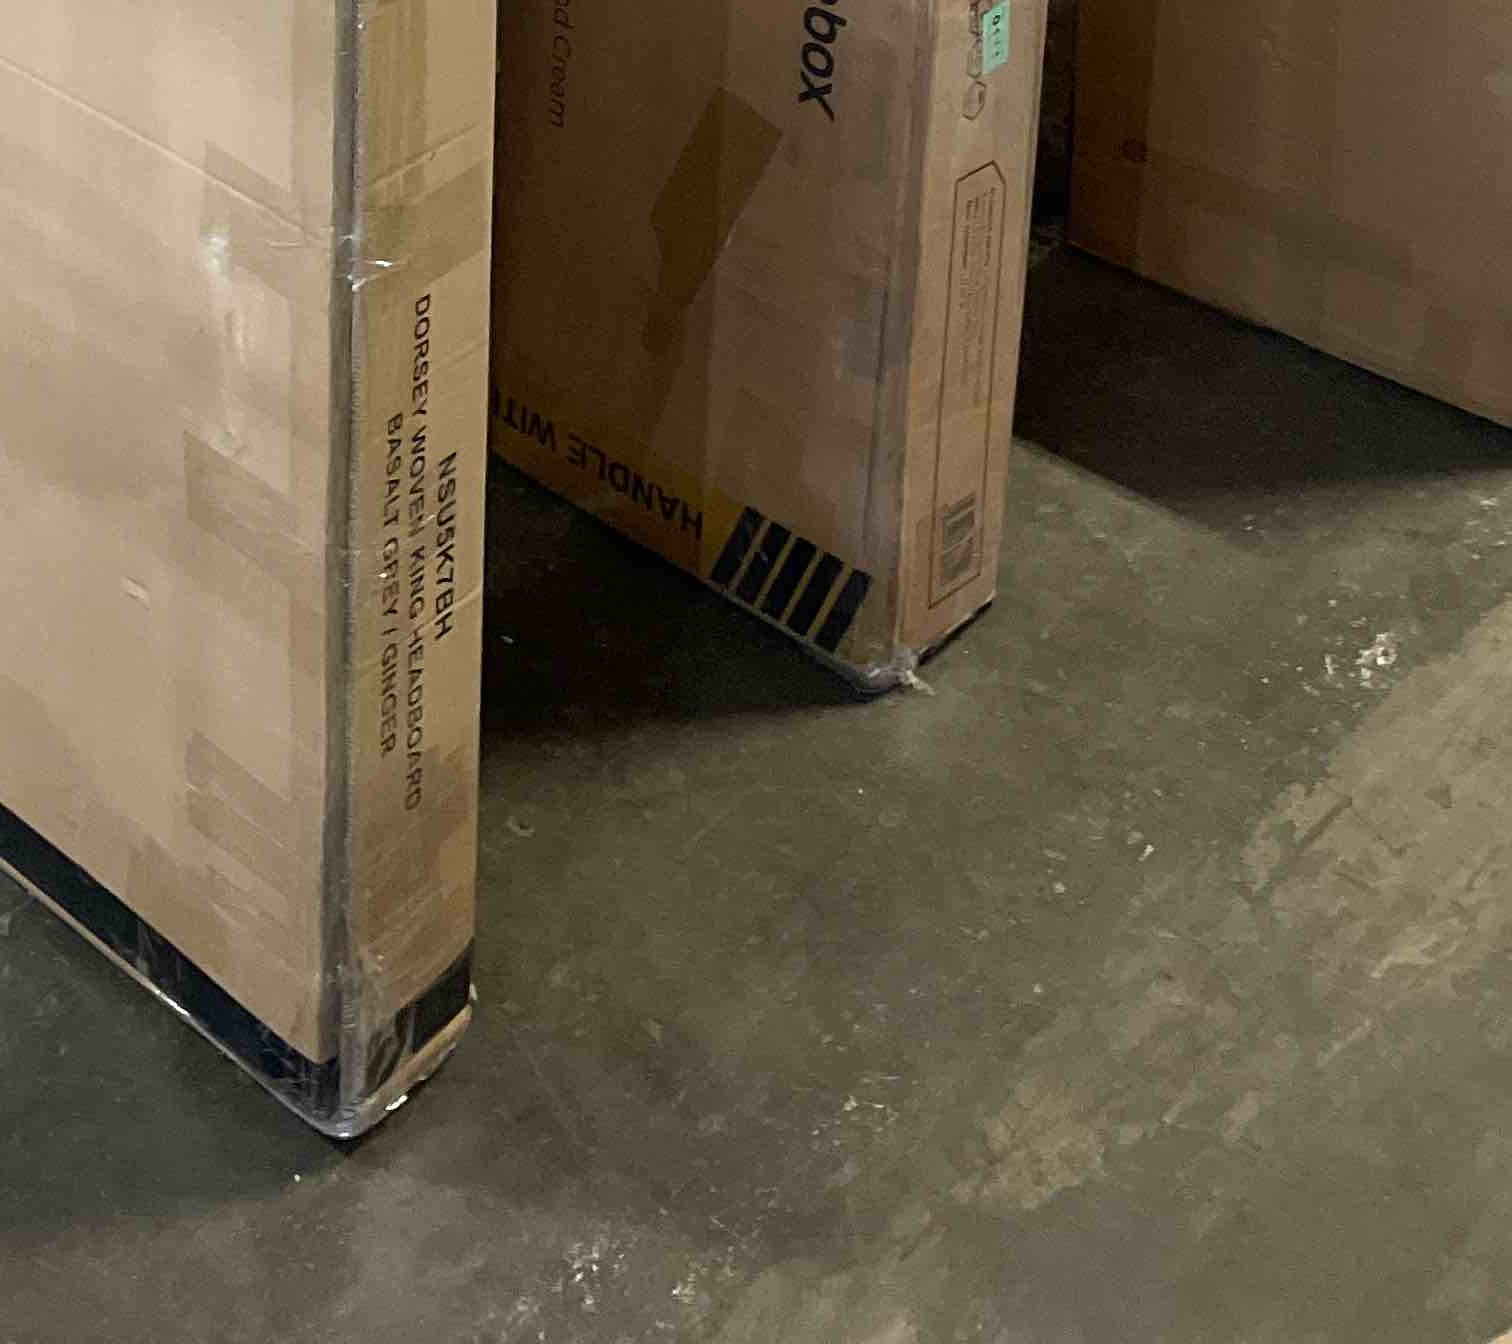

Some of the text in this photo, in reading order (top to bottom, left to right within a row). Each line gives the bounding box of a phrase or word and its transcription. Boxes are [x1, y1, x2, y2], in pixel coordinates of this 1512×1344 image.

[551, 34, 573, 129] Cream
[384, 412, 405, 529] BASALT
[566, 431, 703, 541] HANDLE
[382, 532, 400, 618] GREY
[405, 292, 432, 812] DORSEY WOVEN KING HEADBOARD
[435, 450, 458, 642] NSU5K7BH
[380, 638, 400, 753] GINGER
